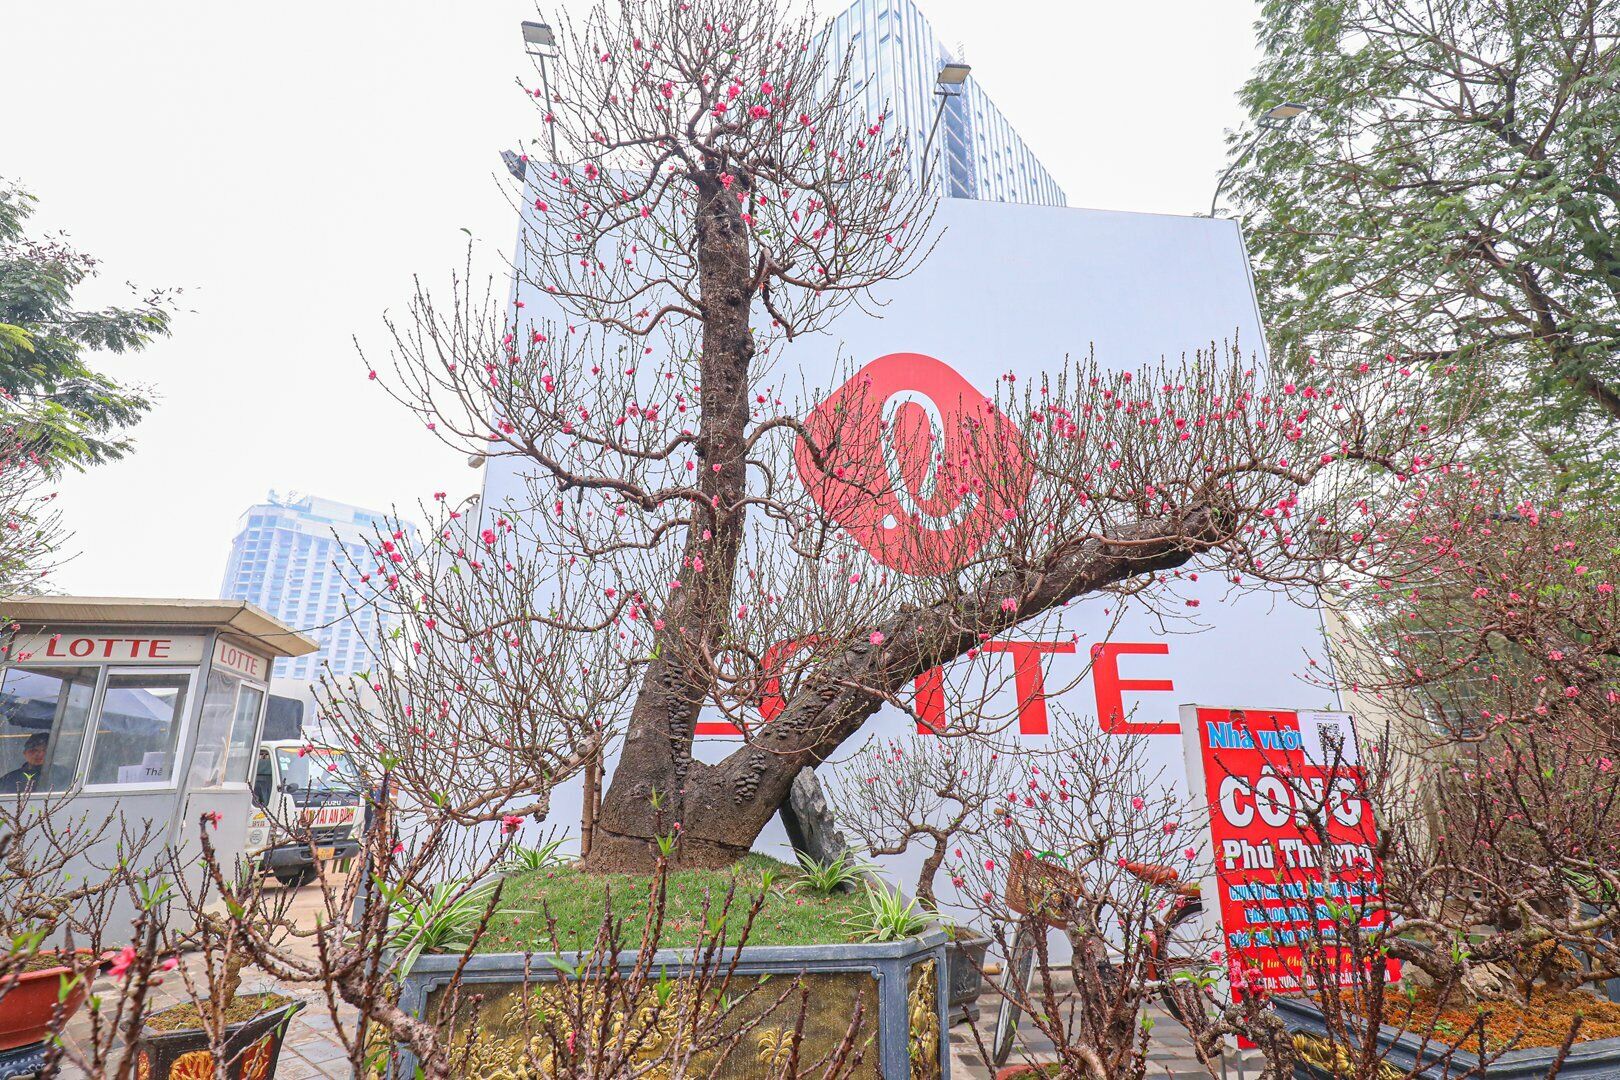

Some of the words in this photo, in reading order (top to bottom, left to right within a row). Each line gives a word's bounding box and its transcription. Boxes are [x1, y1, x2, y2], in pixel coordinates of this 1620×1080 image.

[46, 638, 171, 658] LOTTE
[220, 644, 258, 675] LOTTE
[1206, 722, 1254, 749] Nhà
[1220, 765, 1362, 828] CÔNG
[1222, 838, 1275, 870] Phú
[1267, 906, 1290, 925] LOẠ
